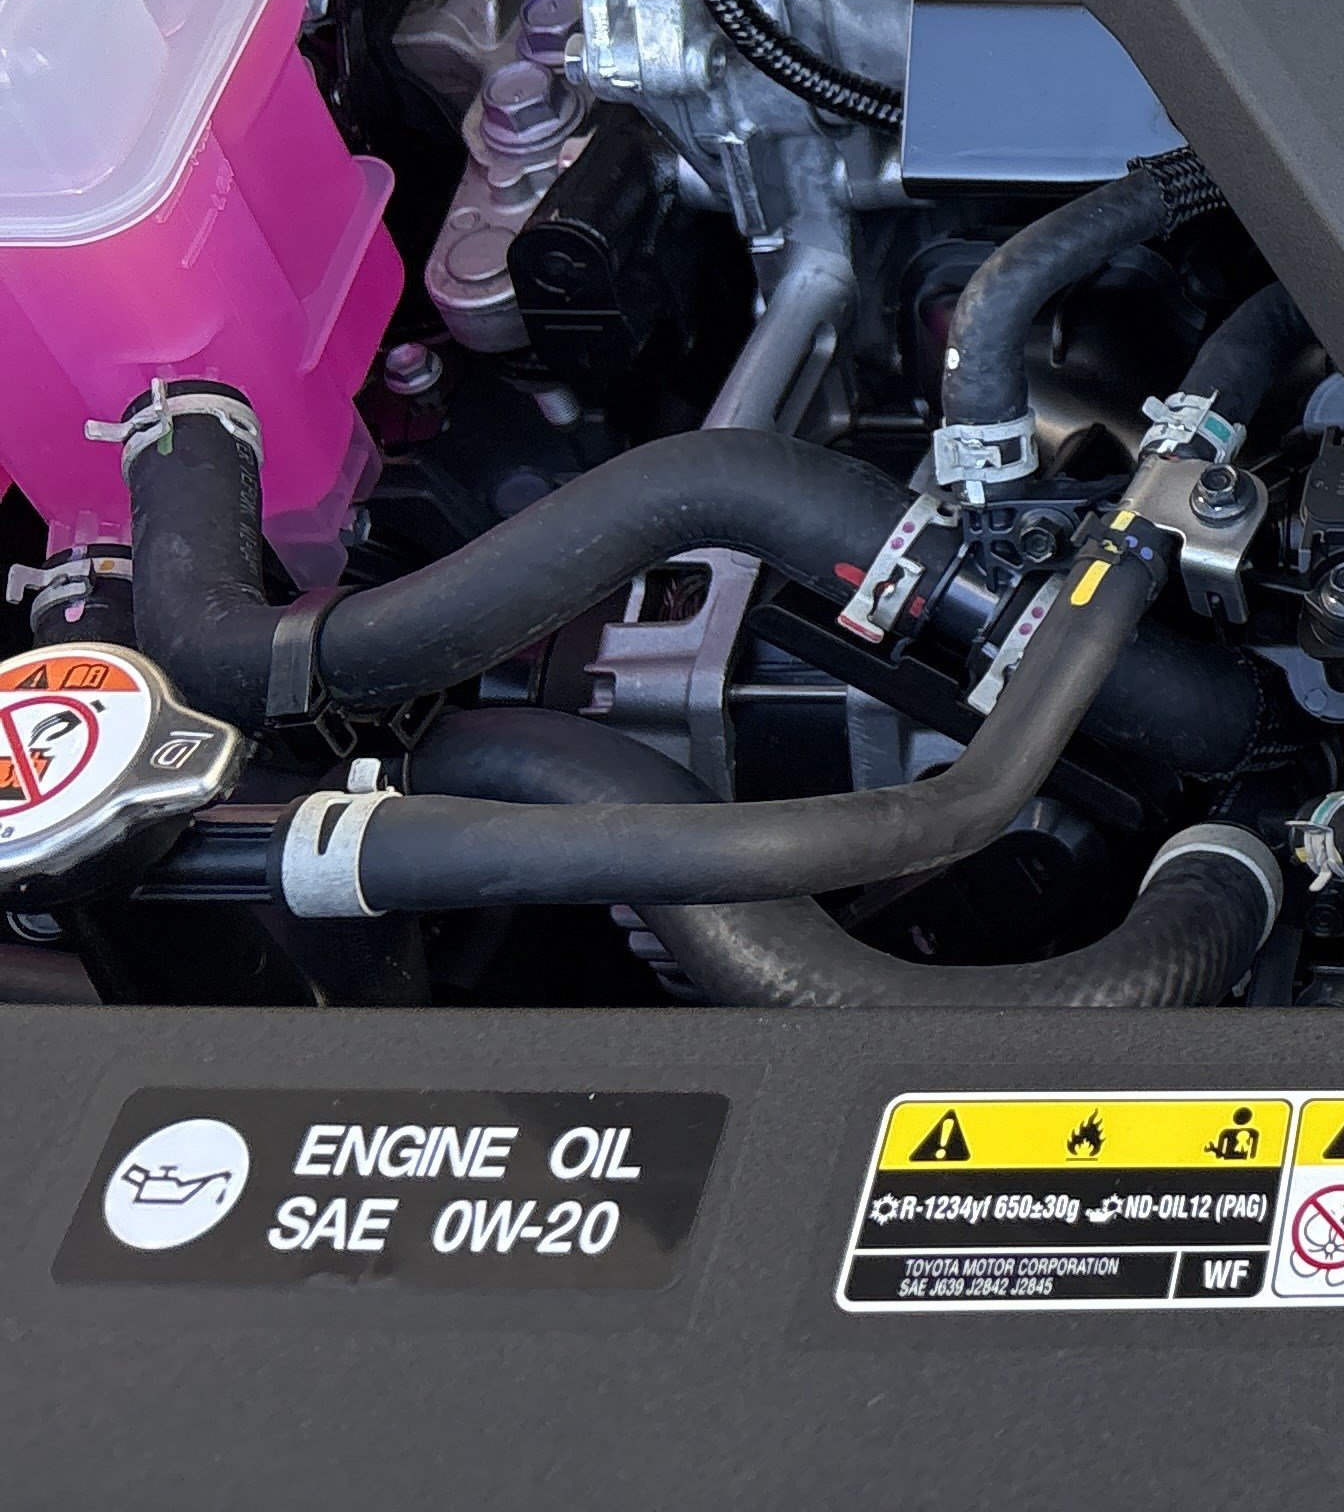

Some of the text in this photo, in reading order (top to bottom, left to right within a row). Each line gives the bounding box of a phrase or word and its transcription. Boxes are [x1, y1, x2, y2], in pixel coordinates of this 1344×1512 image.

[294, 1124, 641, 1180] ENGINE OIL
[267, 1196, 620, 1255] SAE 0W-20
[900, 1193, 1268, 1226] R-1234yf 650±30g ND-OIL12 (PAG)
[899, 1277, 1053, 1296] SAE J639 J2842 J2845
[905, 1257, 1250, 1289] TOYOTA MOTOR CORPORATION WF
